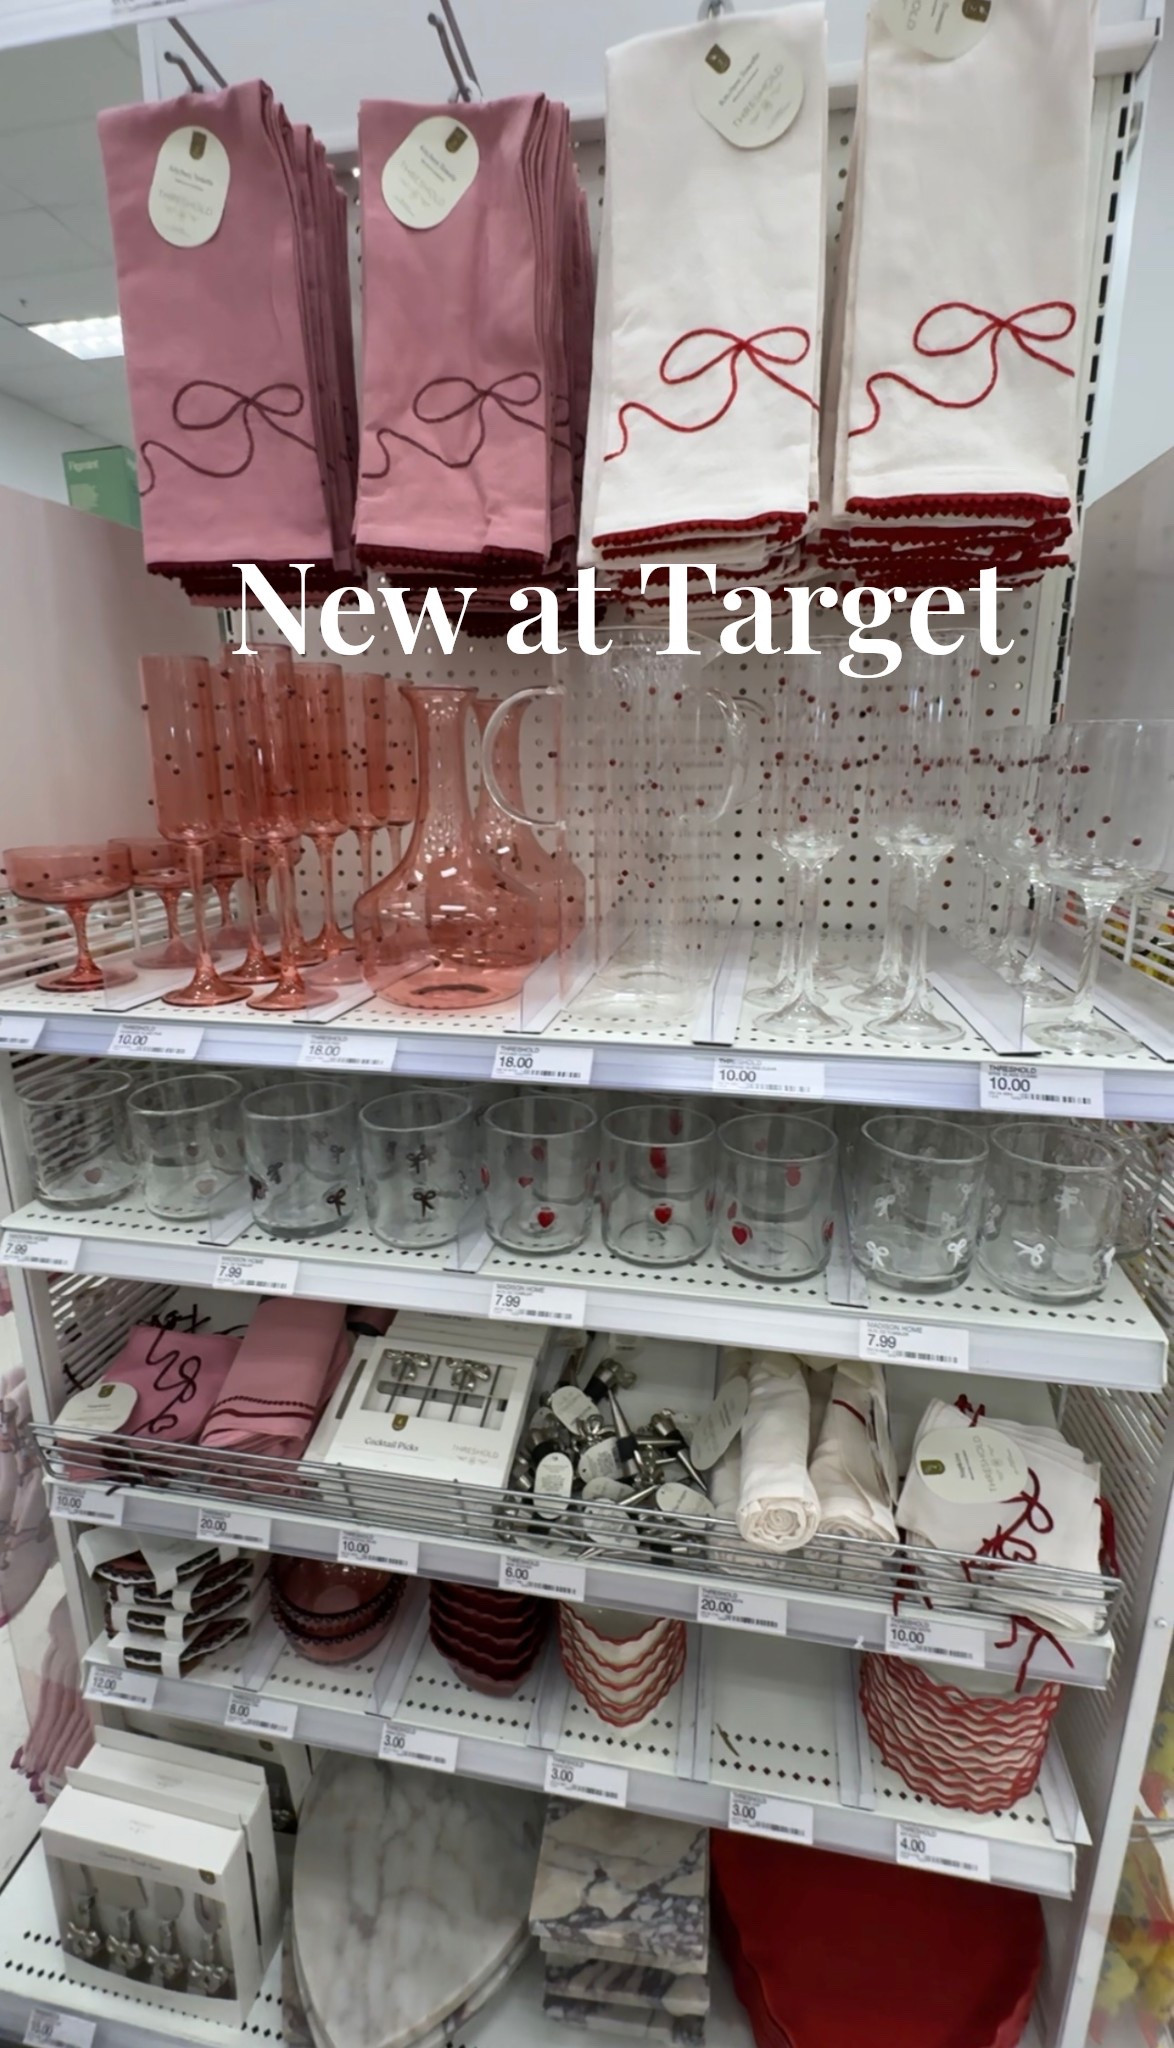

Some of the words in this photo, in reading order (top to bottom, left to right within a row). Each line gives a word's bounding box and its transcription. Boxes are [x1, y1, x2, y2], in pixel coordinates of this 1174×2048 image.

[118, 1034, 148, 1047] 10.00
[309, 1045, 341, 1057] 18.00
[499, 1056, 534, 1069] 18.00
[719, 1069, 757, 1082] 10.00
[989, 1076, 1031, 1092] 10.00
[5, 1242, 28, 1255] 7.99
[219, 1265, 243, 1278] 7.99
[495, 1294, 521, 1308] 7.99
[867, 1333, 897, 1349] 7.99
[57, 1495, 82, 1508] 10.00
[200, 1518, 227, 1531] 20.00
[343, 1540, 370, 1554] 10.00
[505, 1566, 529, 1580] 6.00
[701, 1599, 733, 1614] 20.00
[891, 1629, 925, 1644] 10.00
[384, 1734, 405, 1749] 3.00
[551, 1767, 574, 1783] 3.00
[732, 1803, 756, 1819] 3.00
[900, 1837, 926, 1853] 4.00
